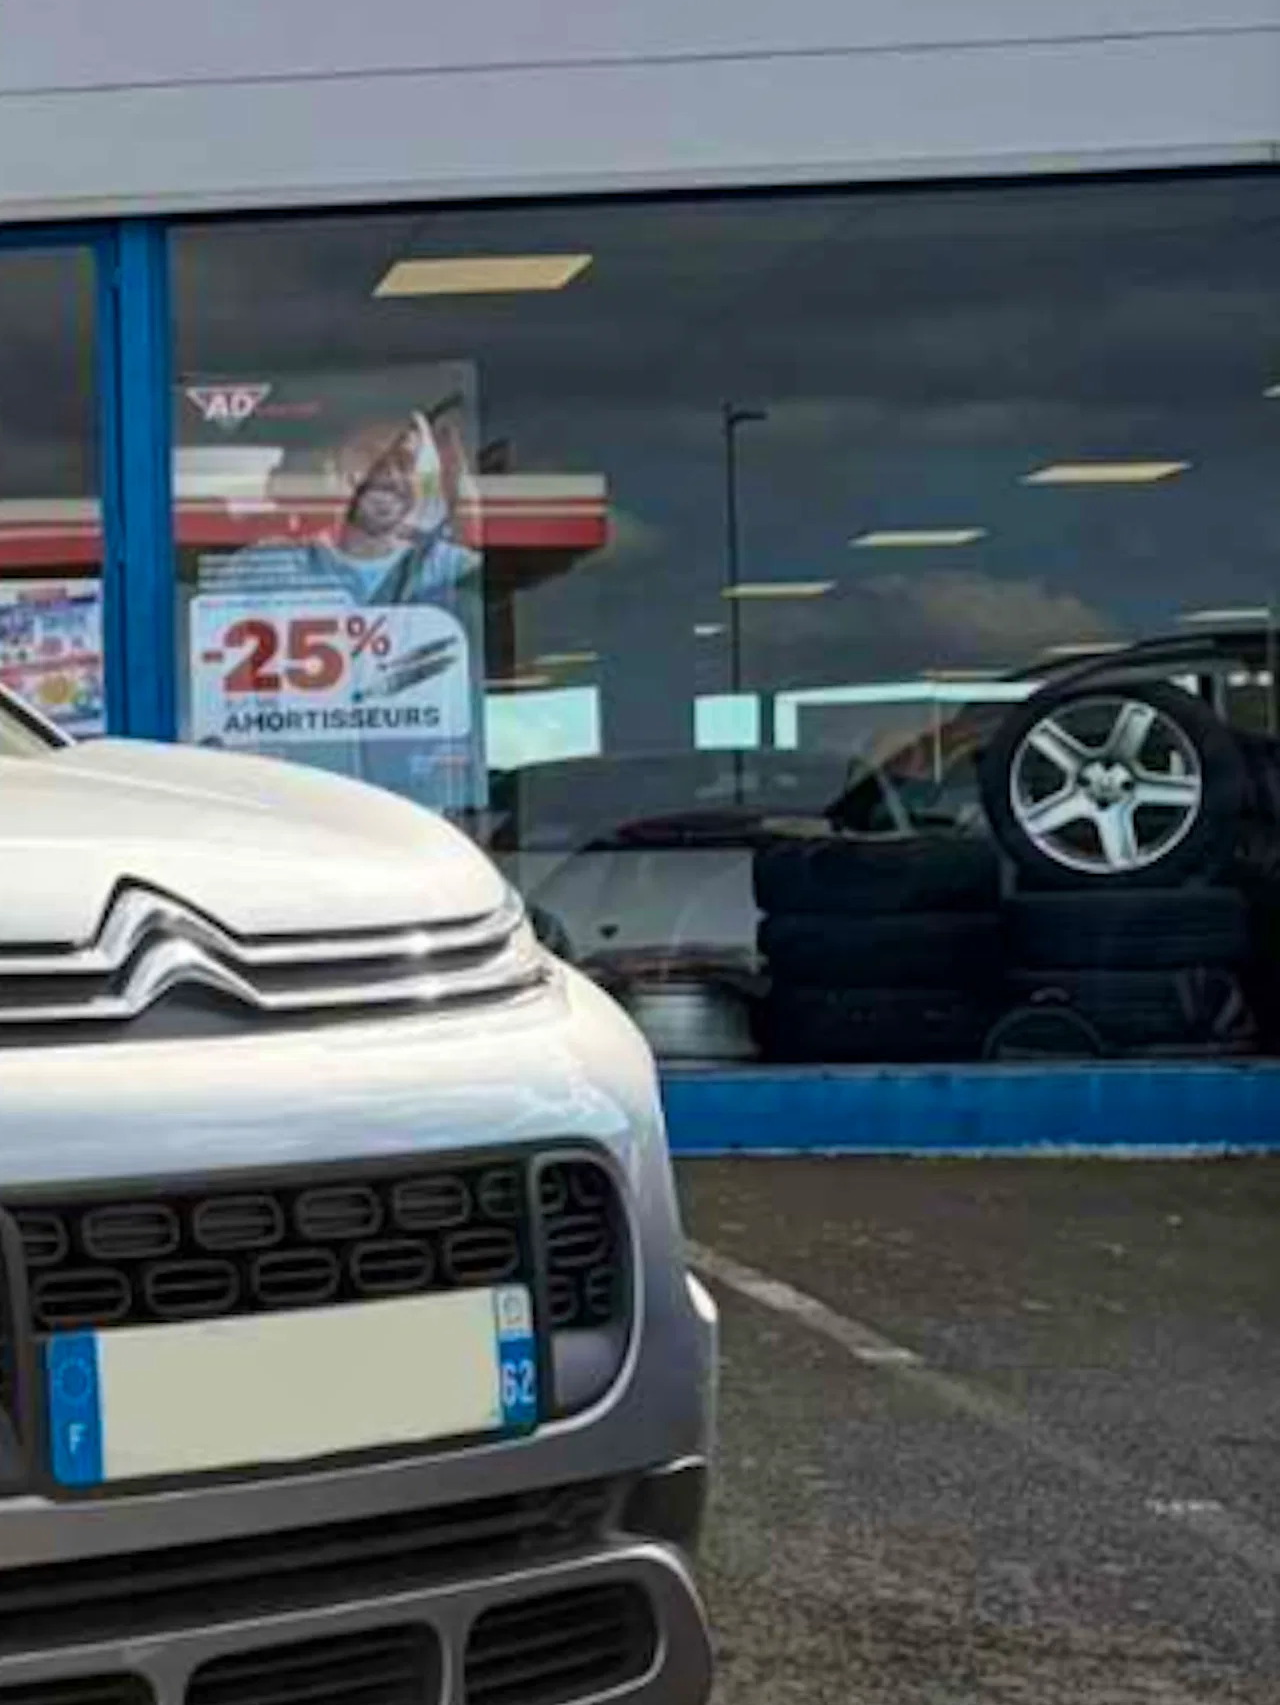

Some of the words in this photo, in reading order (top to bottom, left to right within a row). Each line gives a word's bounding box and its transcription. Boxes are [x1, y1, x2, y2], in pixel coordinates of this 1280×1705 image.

[204, 393, 257, 420] AD
[223, 706, 440, 734] AMORTISSEURS
[501, 1359, 536, 1406] 62
[68, 1423, 85, 1454] F
